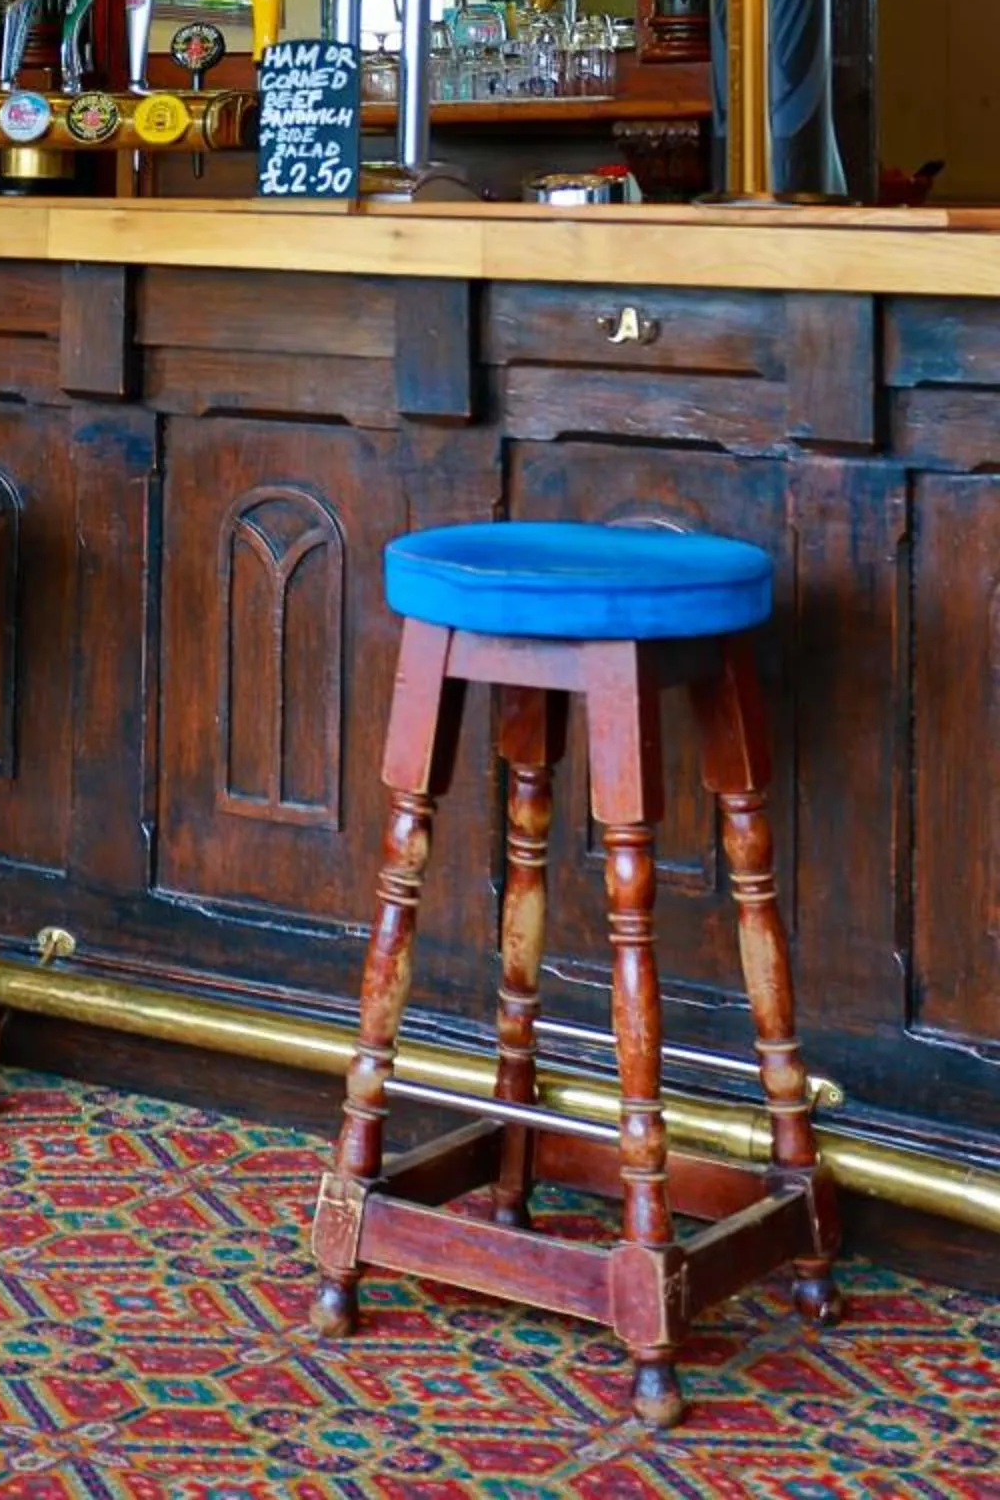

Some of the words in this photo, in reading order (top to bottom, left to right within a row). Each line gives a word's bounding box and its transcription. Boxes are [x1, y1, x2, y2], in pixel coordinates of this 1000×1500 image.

[264, 44, 320, 70] HAM
[325, 46, 357, 69] OR
[261, 67, 348, 90] CORNED
[264, 90, 323, 109] BEEF
[260, 107, 354, 129] SANDWICH
[276, 127, 317, 143] SIDE
[273, 141, 341, 159] SALAD
[260, 156, 353, 194] £2.50
